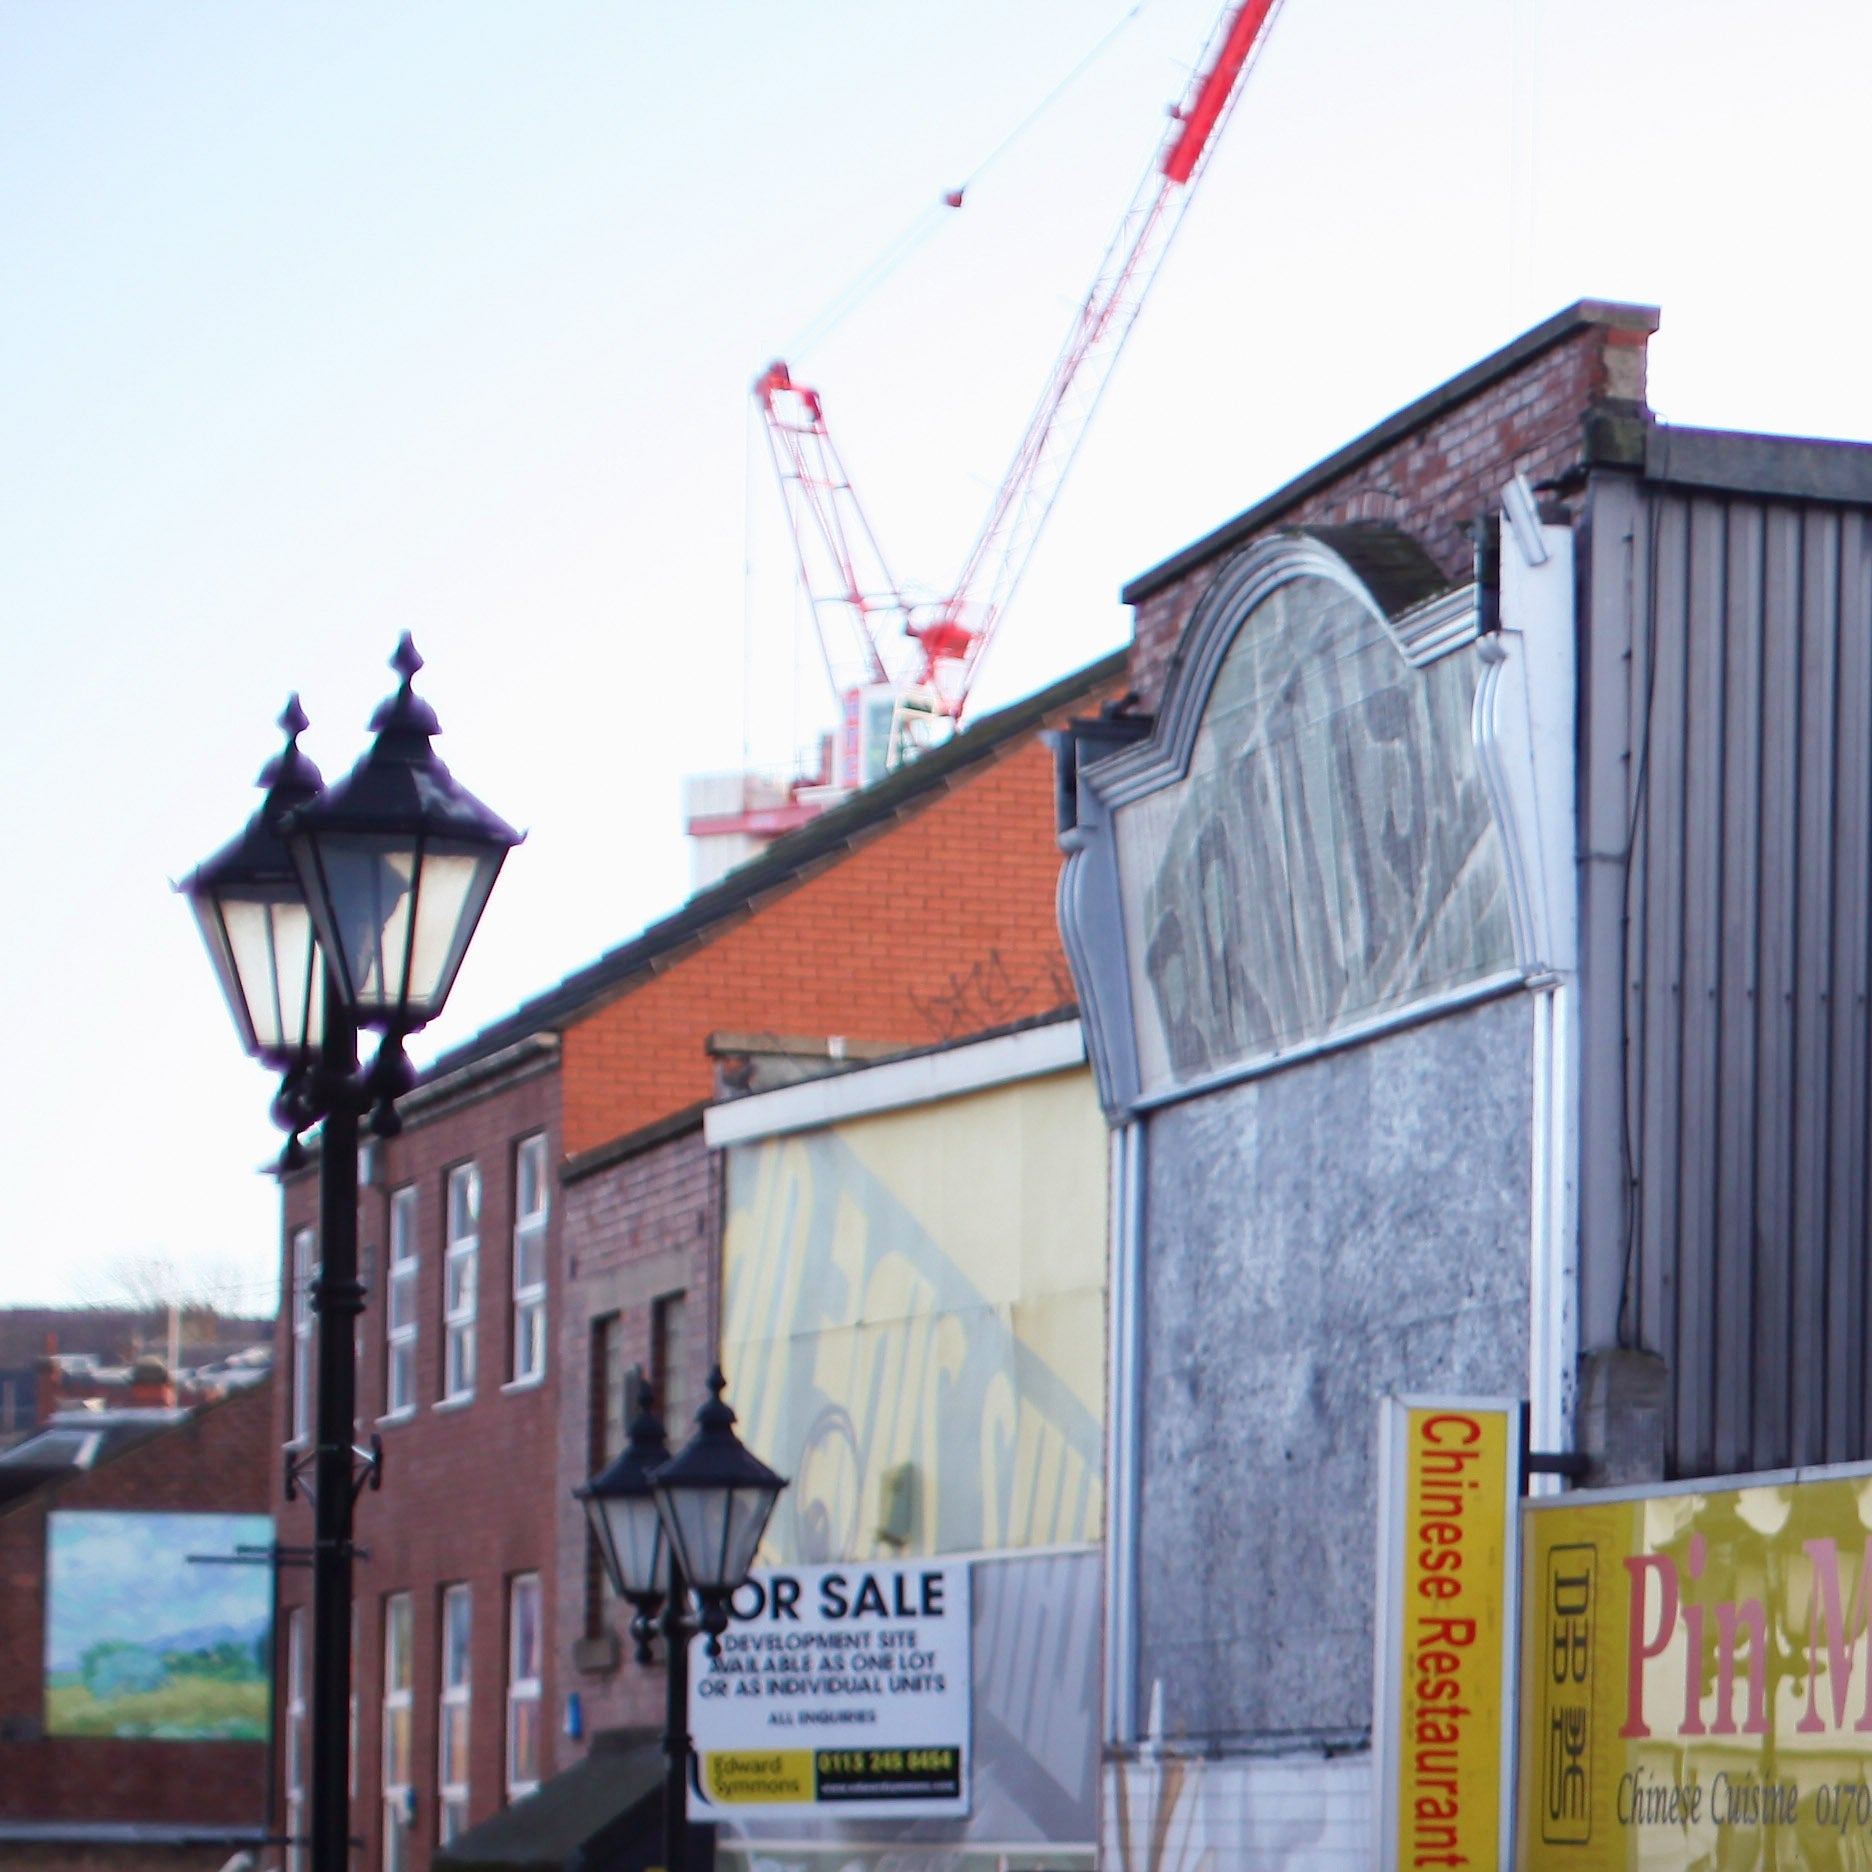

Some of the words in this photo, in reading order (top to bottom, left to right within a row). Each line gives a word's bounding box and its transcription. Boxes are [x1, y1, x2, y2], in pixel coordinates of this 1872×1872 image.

[1417, 1413, 1481, 1599] Chinese
[727, 1576, 801, 1621] OR
[818, 1571, 945, 1619] SALE
[724, 1631, 872, 1651] DEVELOPMENT
[878, 1629, 917, 1648] SITE
[1617, 1532, 1770, 1739] Pin
[708, 1654, 811, 1674] AVAILABLE
[818, 1653, 845, 1671] AS
[851, 1652, 894, 1670] ONE
[899, 1651, 935, 1669] LOT
[698, 1679, 728, 1697] OR
[734, 1679, 761, 1697] AS
[766, 1677, 881, 1696] INDIVIDUAL
[888, 1674, 945, 1692] UNITS
[767, 1711, 794, 1725] ALL
[1413, 1616, 1477, 1869] Restaurant
[714, 1755, 783, 1776] Edward
[1616, 1765, 1703, 1826] Chinese
[1710, 1771, 1799, 1828] Cuisine
